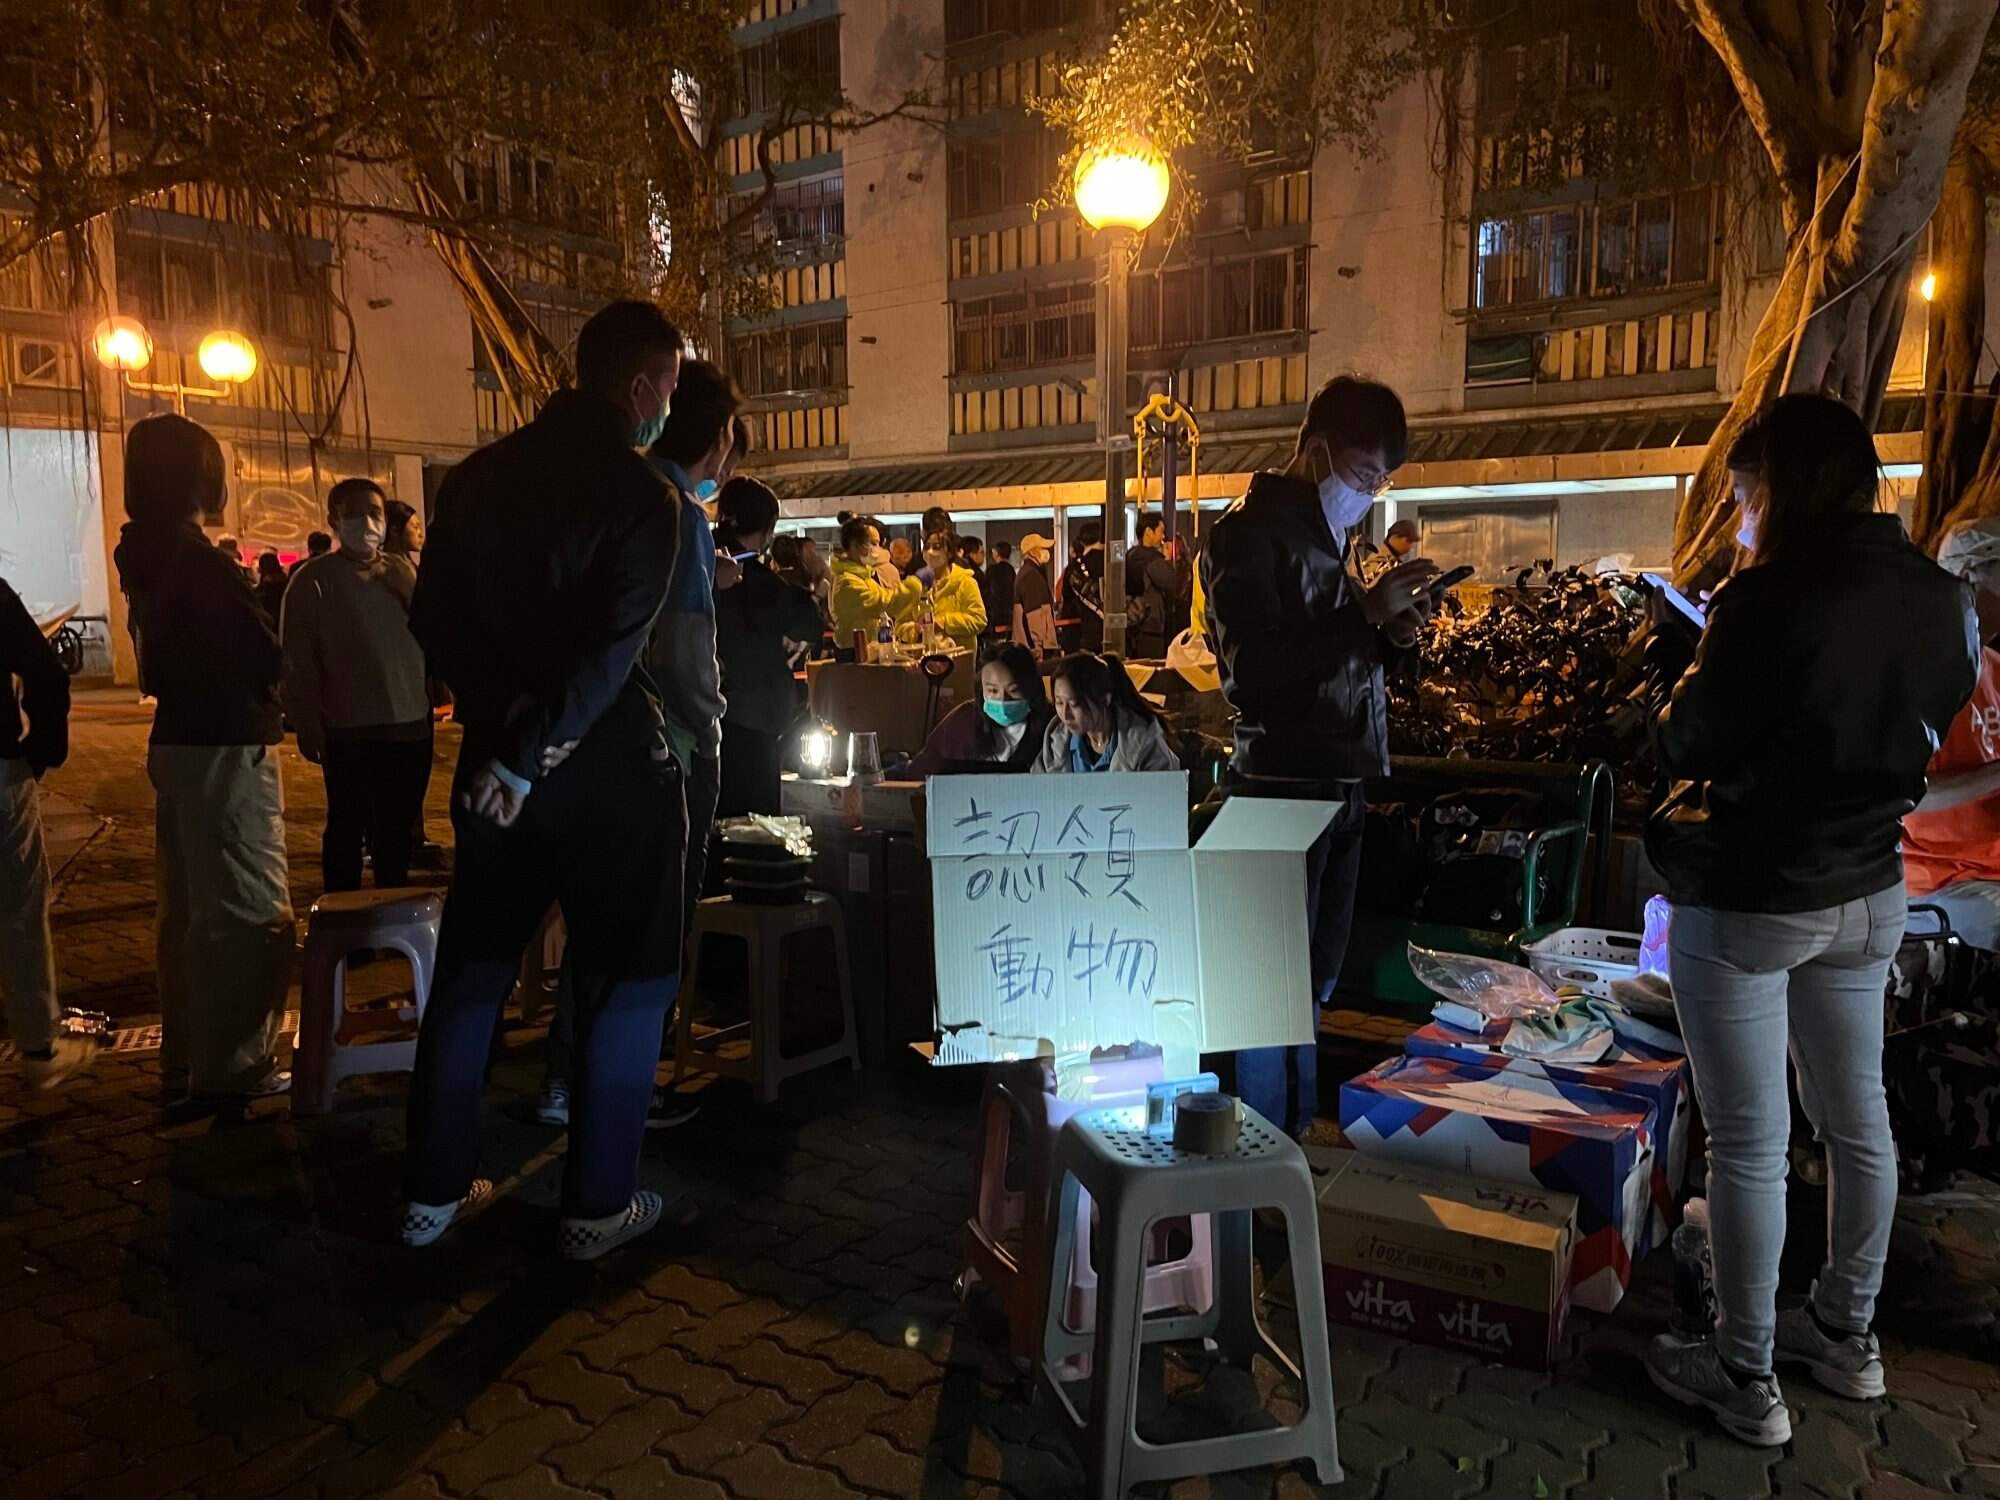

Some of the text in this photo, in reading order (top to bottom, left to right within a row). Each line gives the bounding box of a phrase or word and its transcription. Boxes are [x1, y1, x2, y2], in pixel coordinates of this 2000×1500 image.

[953, 797, 1149, 911] 認領
[974, 922, 1158, 1003] 動物
[1345, 1279, 1416, 1324] vita
[1438, 1299, 1513, 1347] vita
